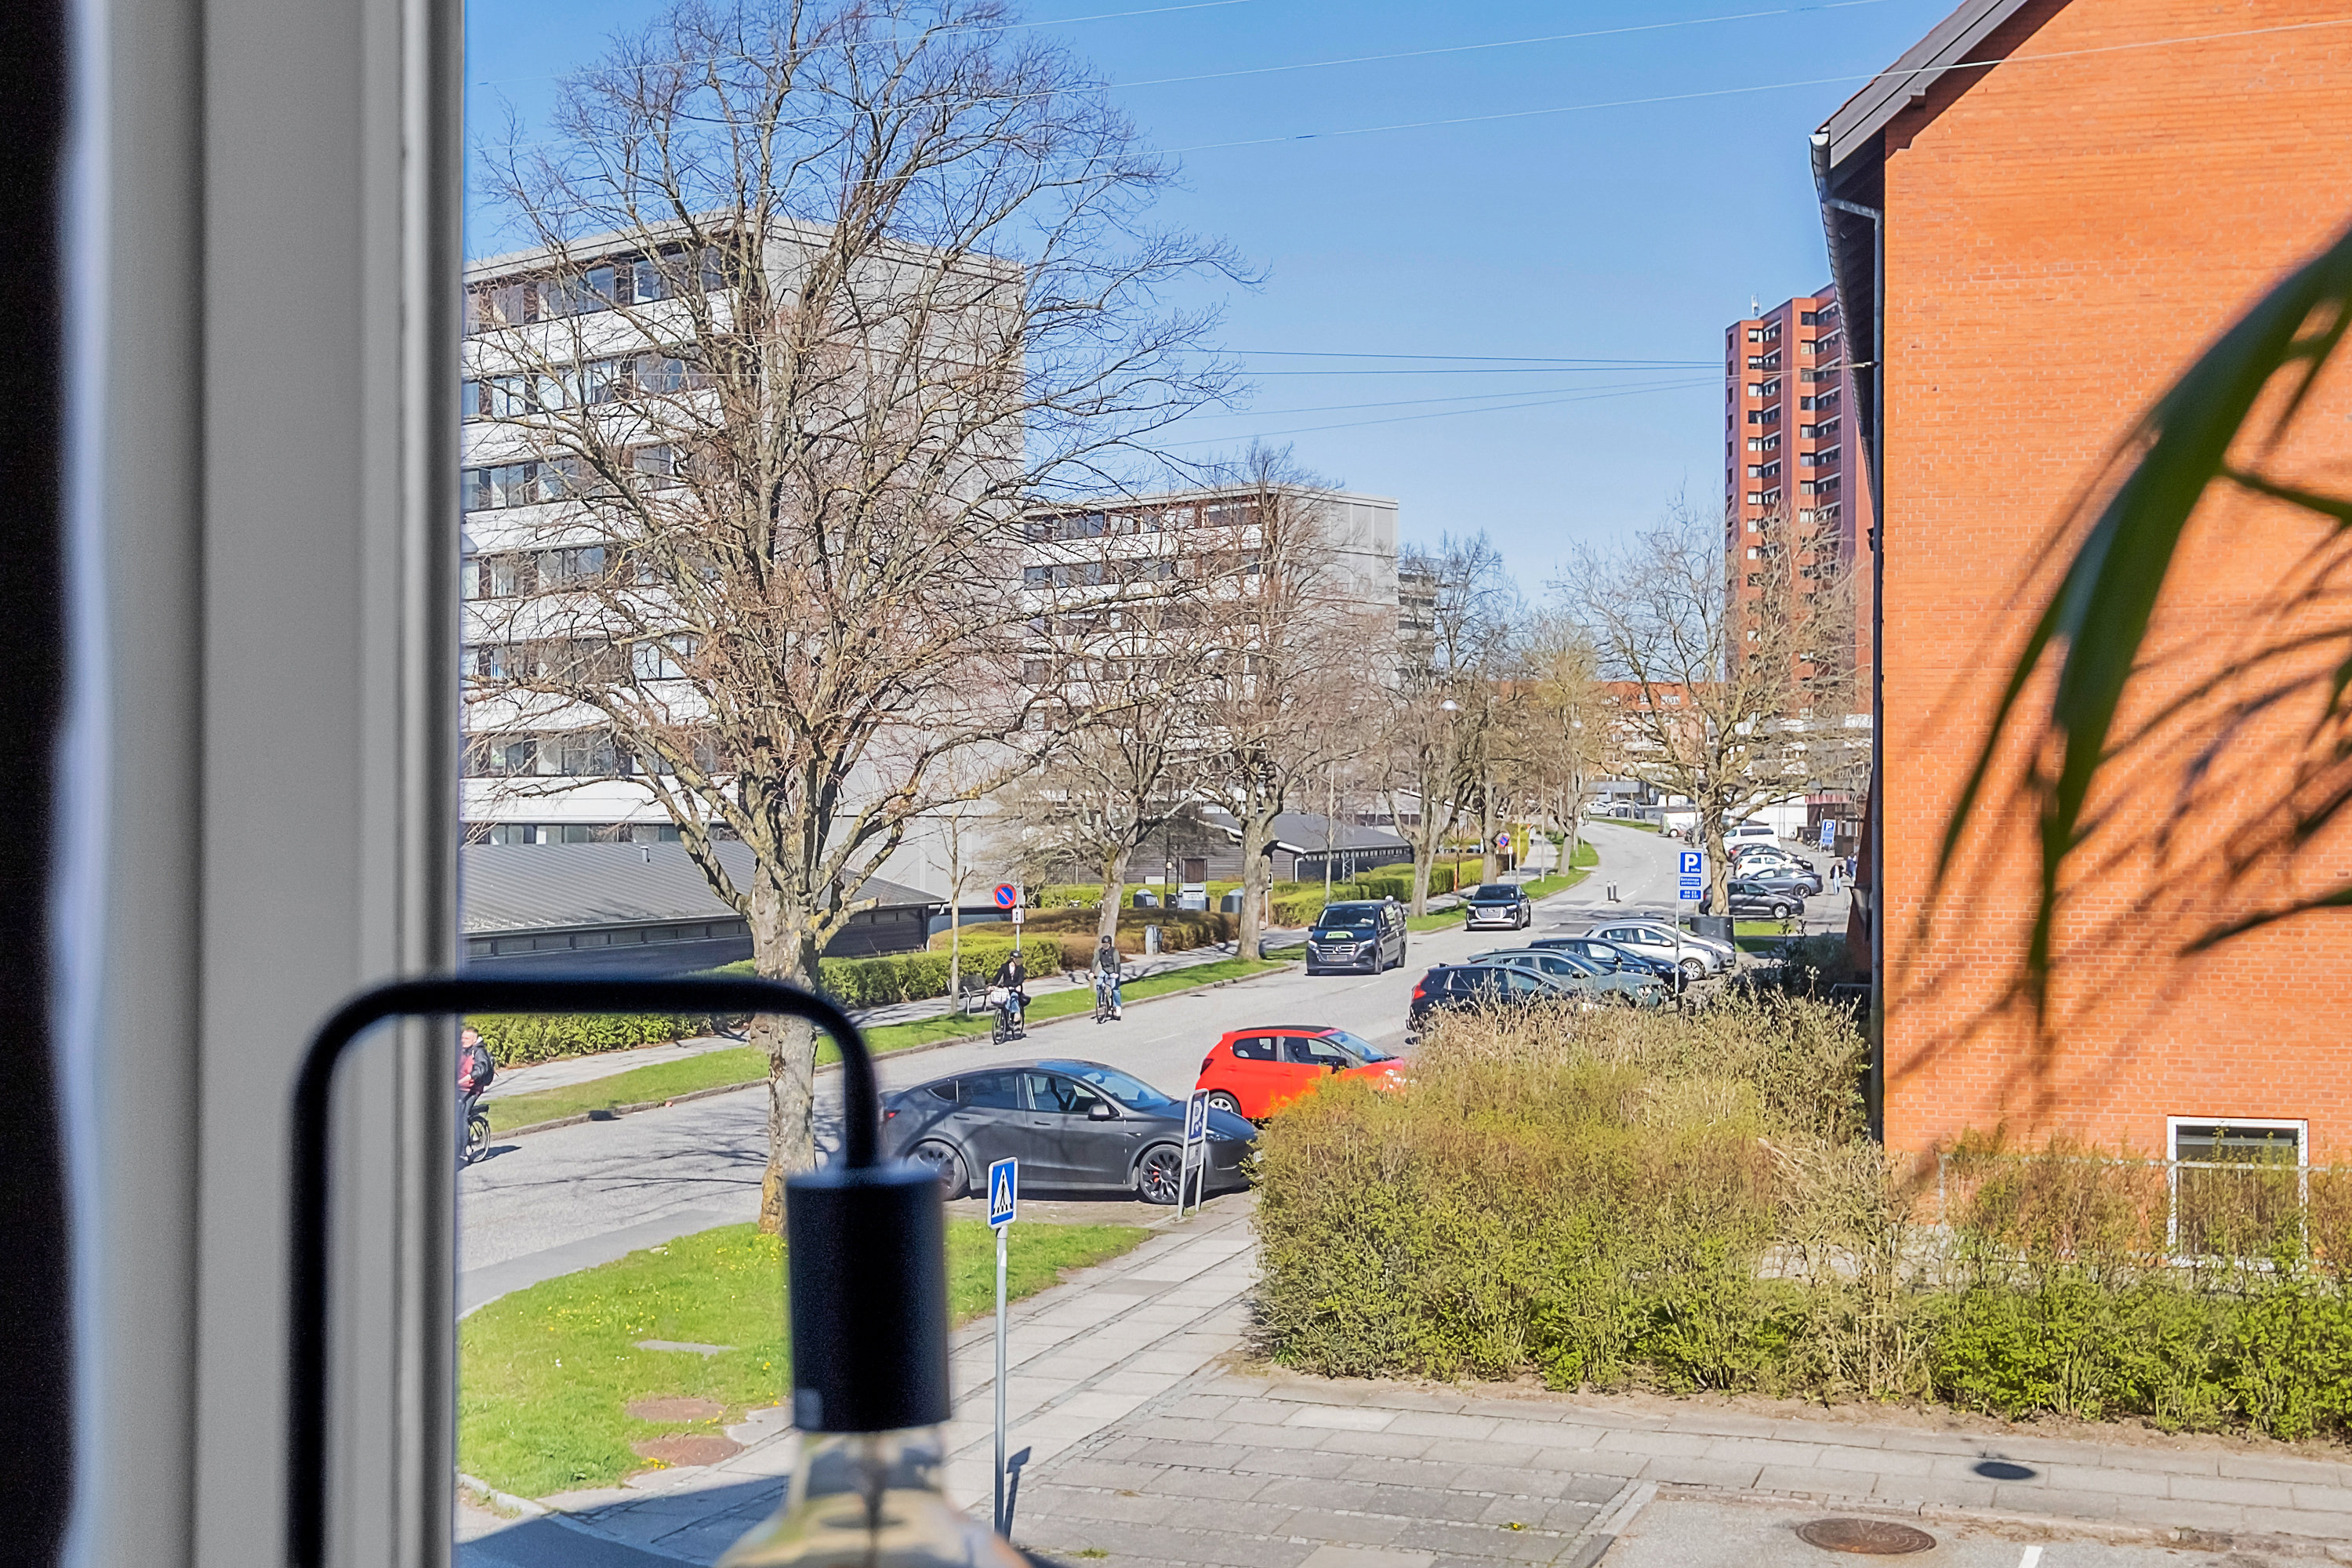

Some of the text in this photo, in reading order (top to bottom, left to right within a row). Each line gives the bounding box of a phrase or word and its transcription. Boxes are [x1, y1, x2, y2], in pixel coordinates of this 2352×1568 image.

[1826, 822, 1833, 831] P
[1685, 853, 1698, 872] P
[1191, 1100, 1203, 1135] P
